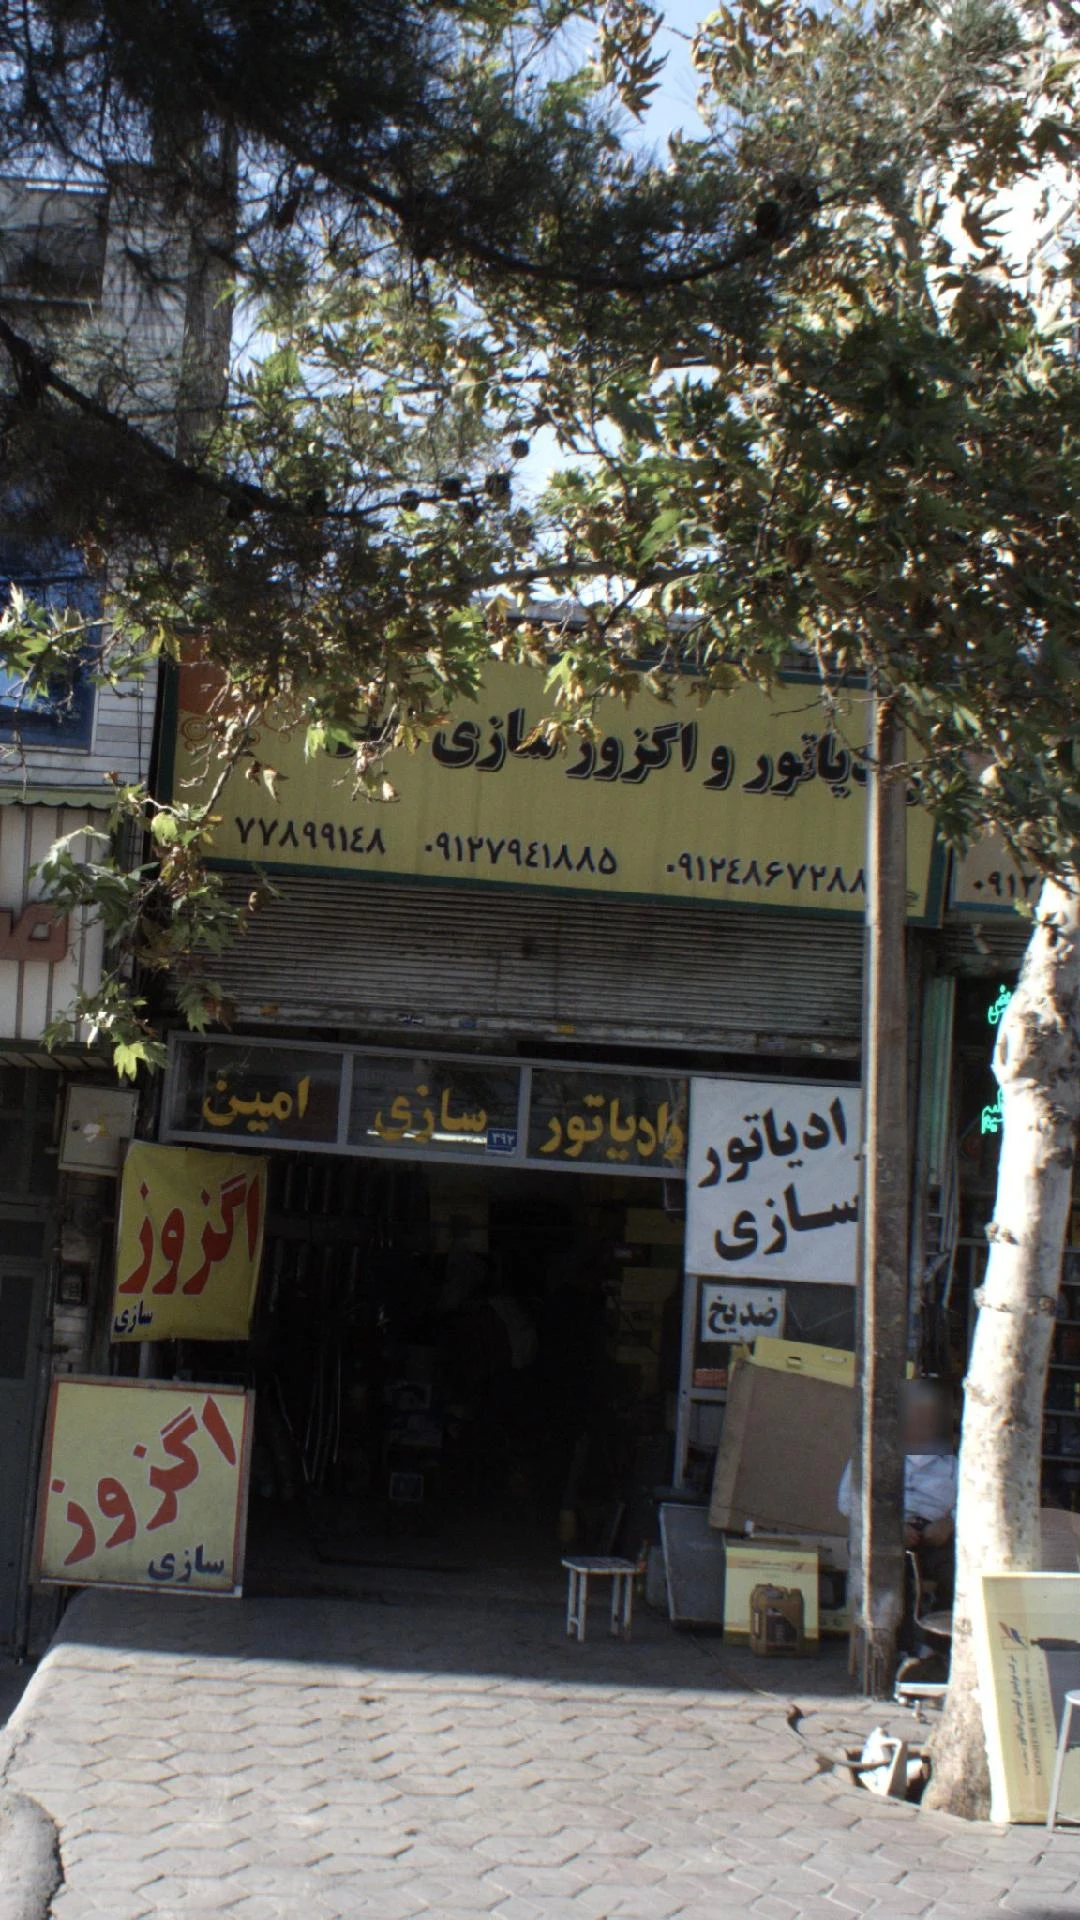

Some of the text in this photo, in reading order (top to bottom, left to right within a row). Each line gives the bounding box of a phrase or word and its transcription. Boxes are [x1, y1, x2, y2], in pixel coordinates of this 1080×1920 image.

[432, 707, 561, 772] سازی
[703, 744, 734, 791] و
[972, 871, 1038, 897] ۰۹۱۲
[202, 1076, 685, 1160] رادیاتور سازی امین
[698, 1096, 862, 1188] ادیاتور
[118, 1174, 260, 1295] اگزوز
[714, 1182, 860, 1262] سازی
[112, 1299, 154, 1335] سازی
[708, 1295, 778, 1334] ضدیخ
[49, 1394, 237, 1567] اگزوز
[147, 1544, 225, 1582] سازی
